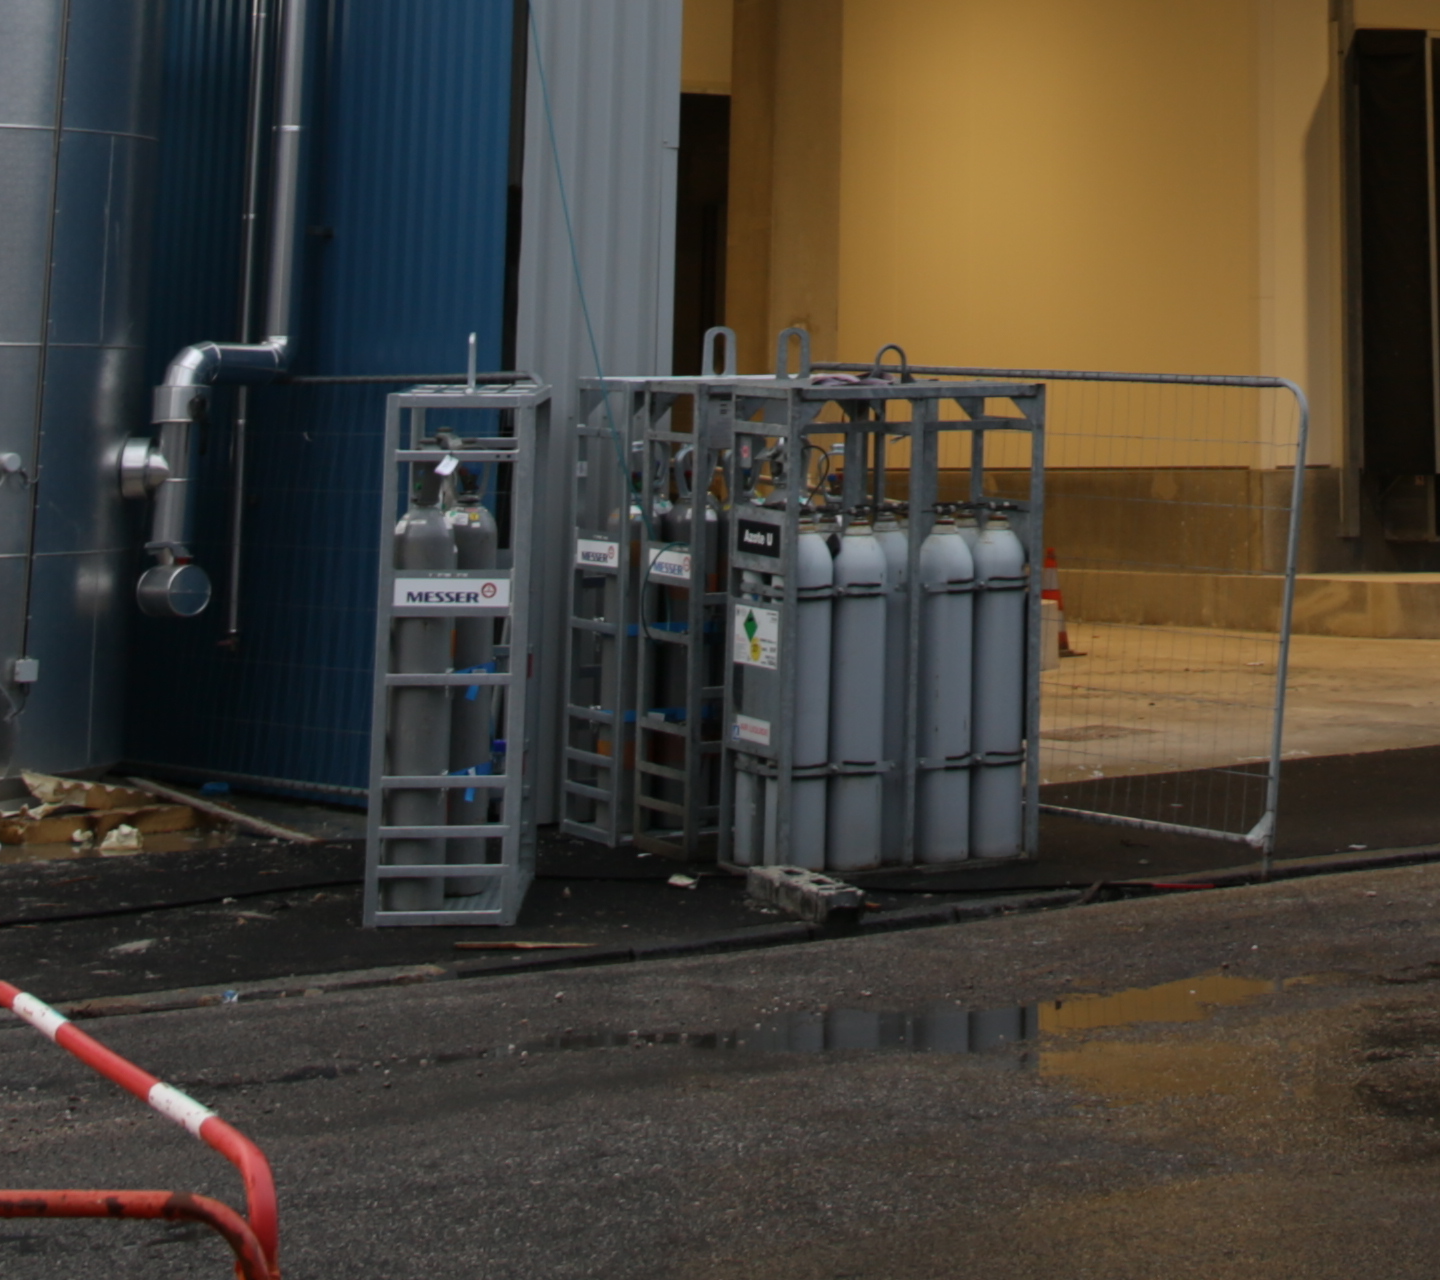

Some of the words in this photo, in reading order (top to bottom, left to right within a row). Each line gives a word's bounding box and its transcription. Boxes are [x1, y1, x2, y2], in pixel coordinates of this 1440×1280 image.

[766, 532, 774, 547] U
[581, 551, 609, 563] MESSER
[653, 561, 684, 576] MESSER
[406, 591, 479, 603] MESSER
